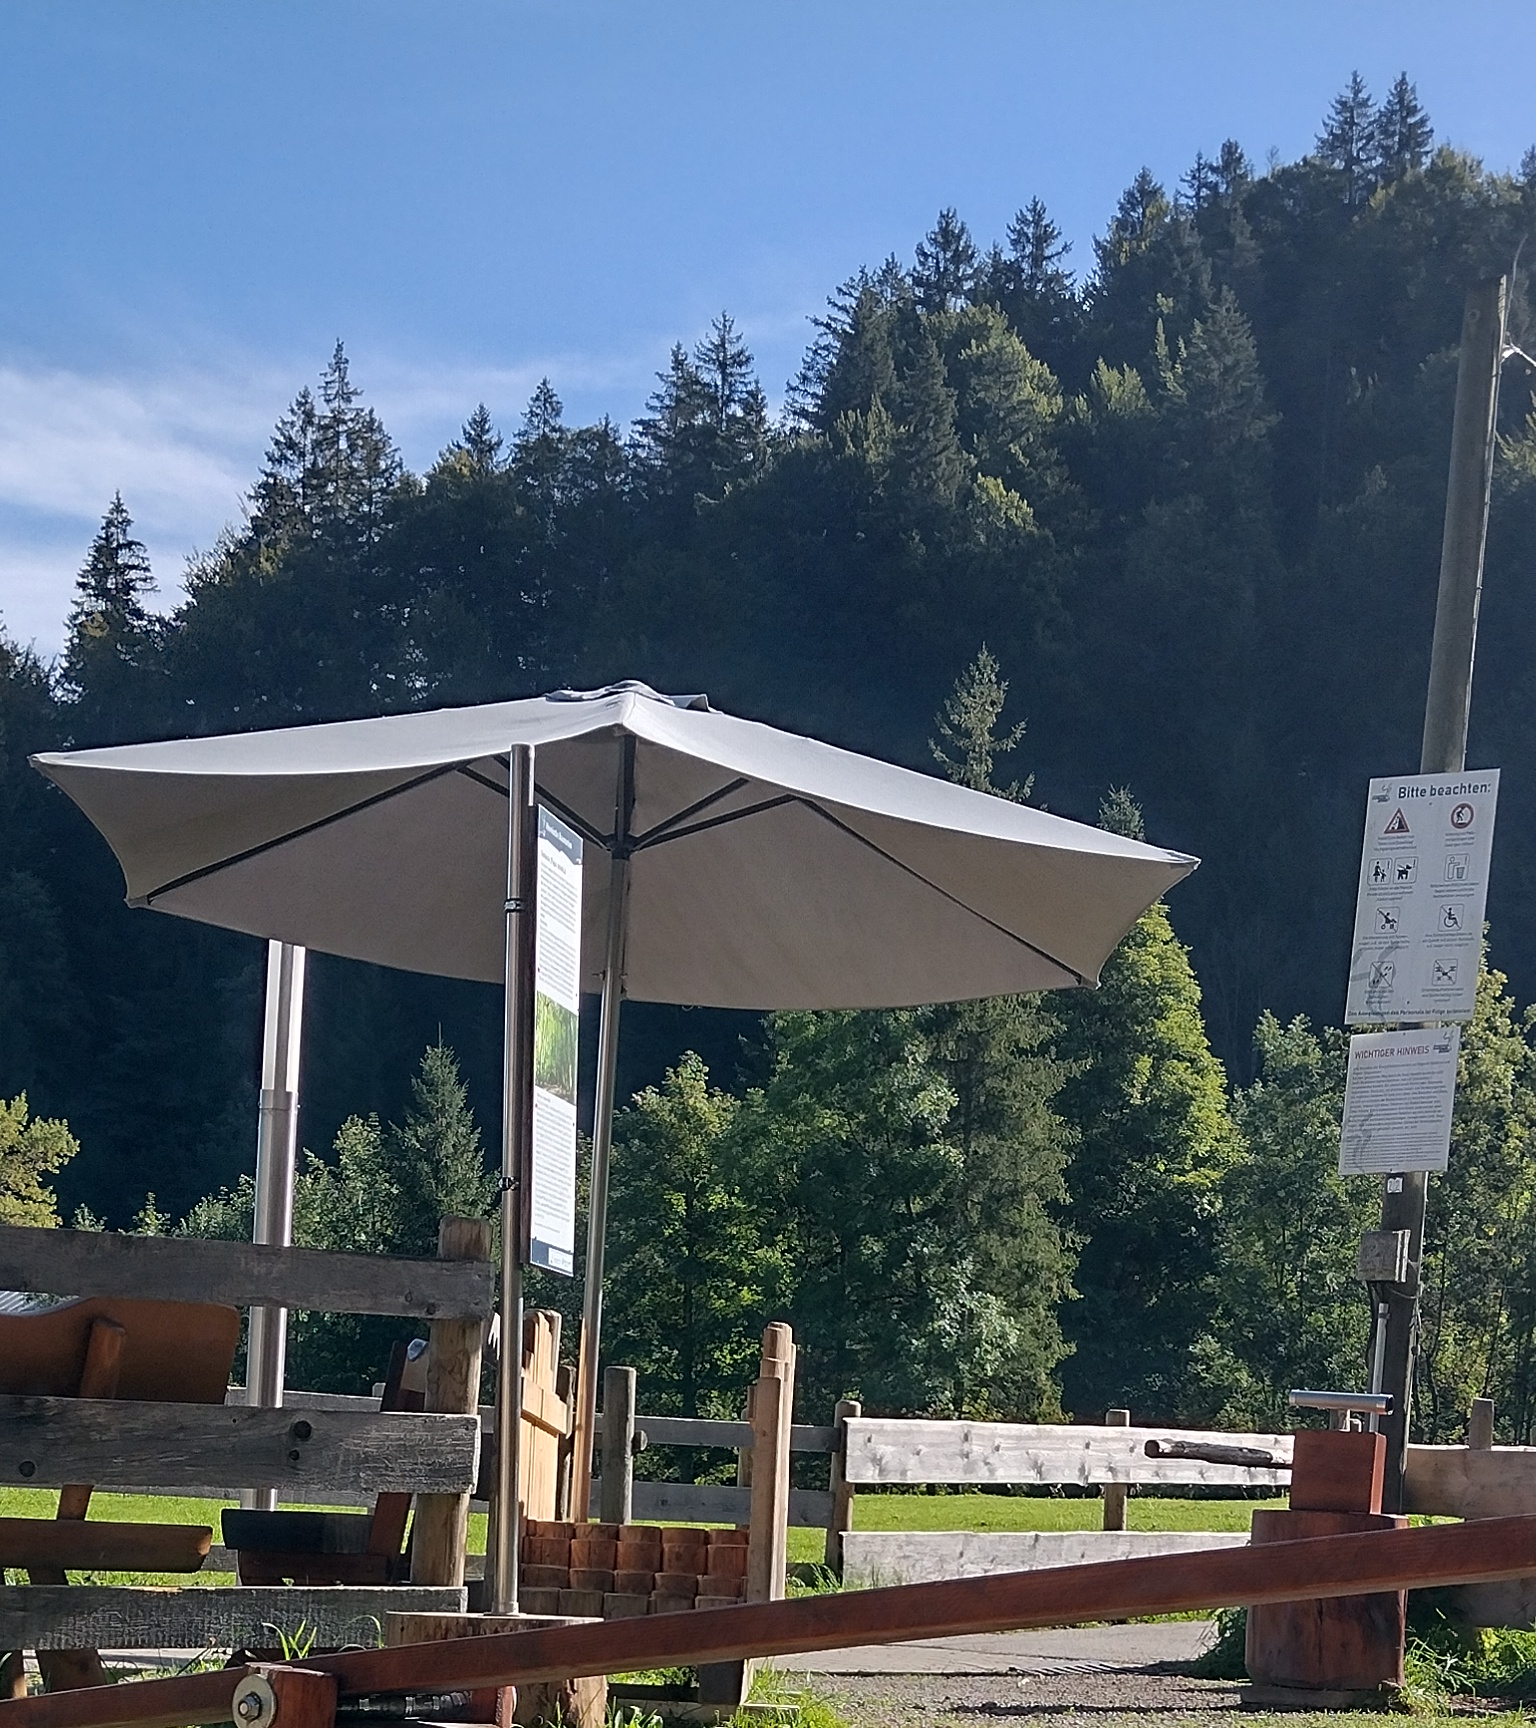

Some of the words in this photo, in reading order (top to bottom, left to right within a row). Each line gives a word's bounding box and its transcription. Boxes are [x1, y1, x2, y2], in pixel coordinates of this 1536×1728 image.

[1398, 784, 1427, 799] Bitte
[1429, 782, 1492, 797] beachten:
[1354, 1048, 1395, 1059] WICHTIGER
[1397, 1045, 1430, 1056] HINWEIS
